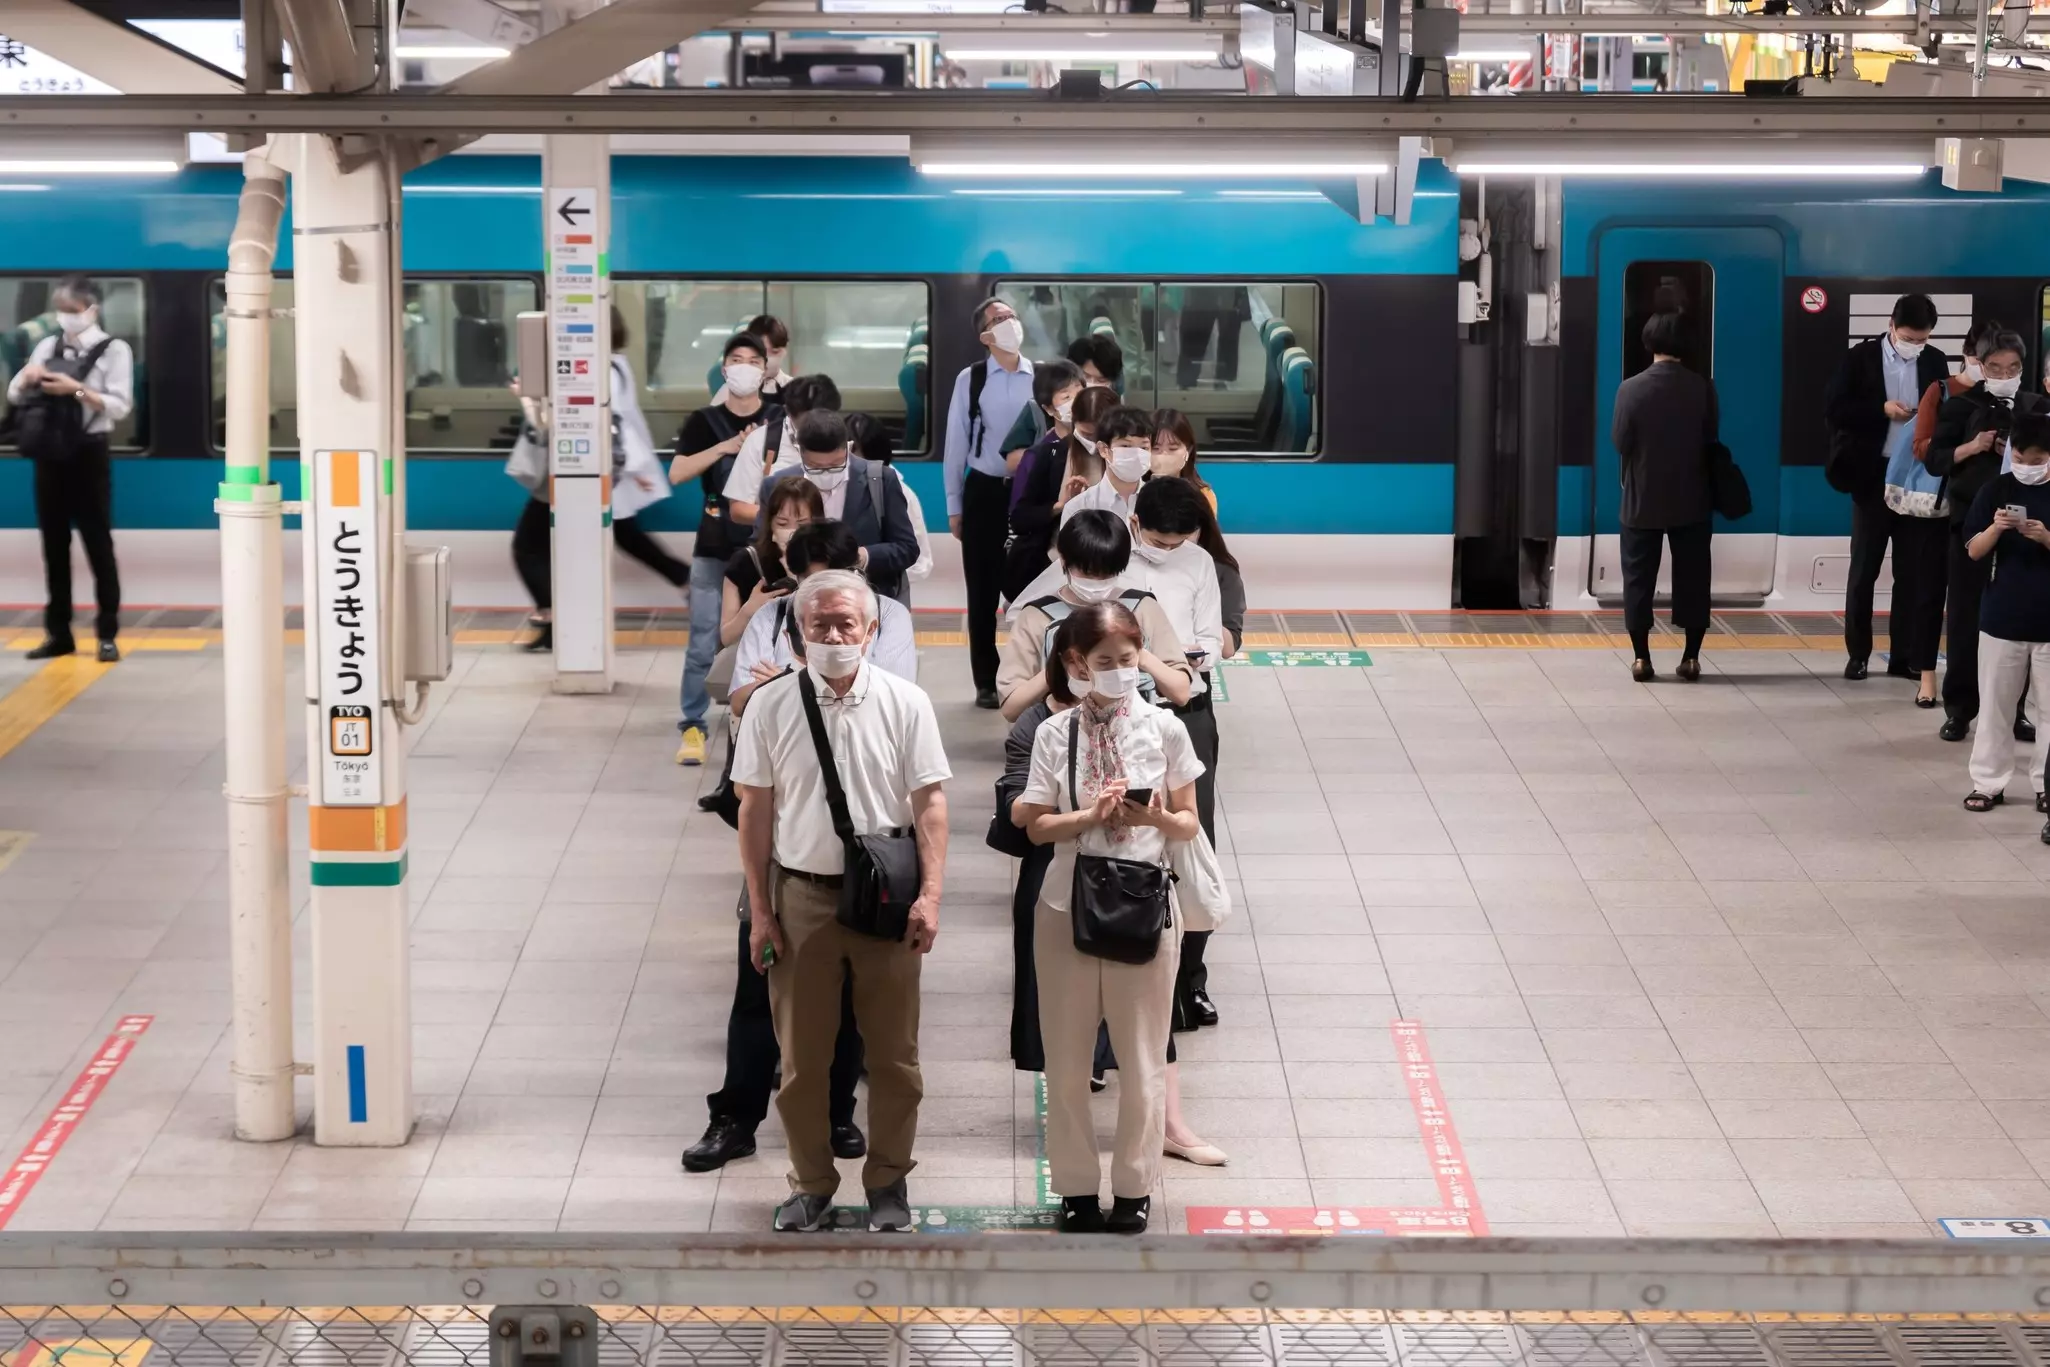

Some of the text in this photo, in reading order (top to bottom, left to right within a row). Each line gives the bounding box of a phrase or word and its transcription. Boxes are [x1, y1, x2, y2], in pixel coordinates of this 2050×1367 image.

[332, 521, 366, 695] とうきょう
[336, 706, 364, 717] TYO
[344, 722, 357, 732] JT
[341, 733, 360, 747] 01
